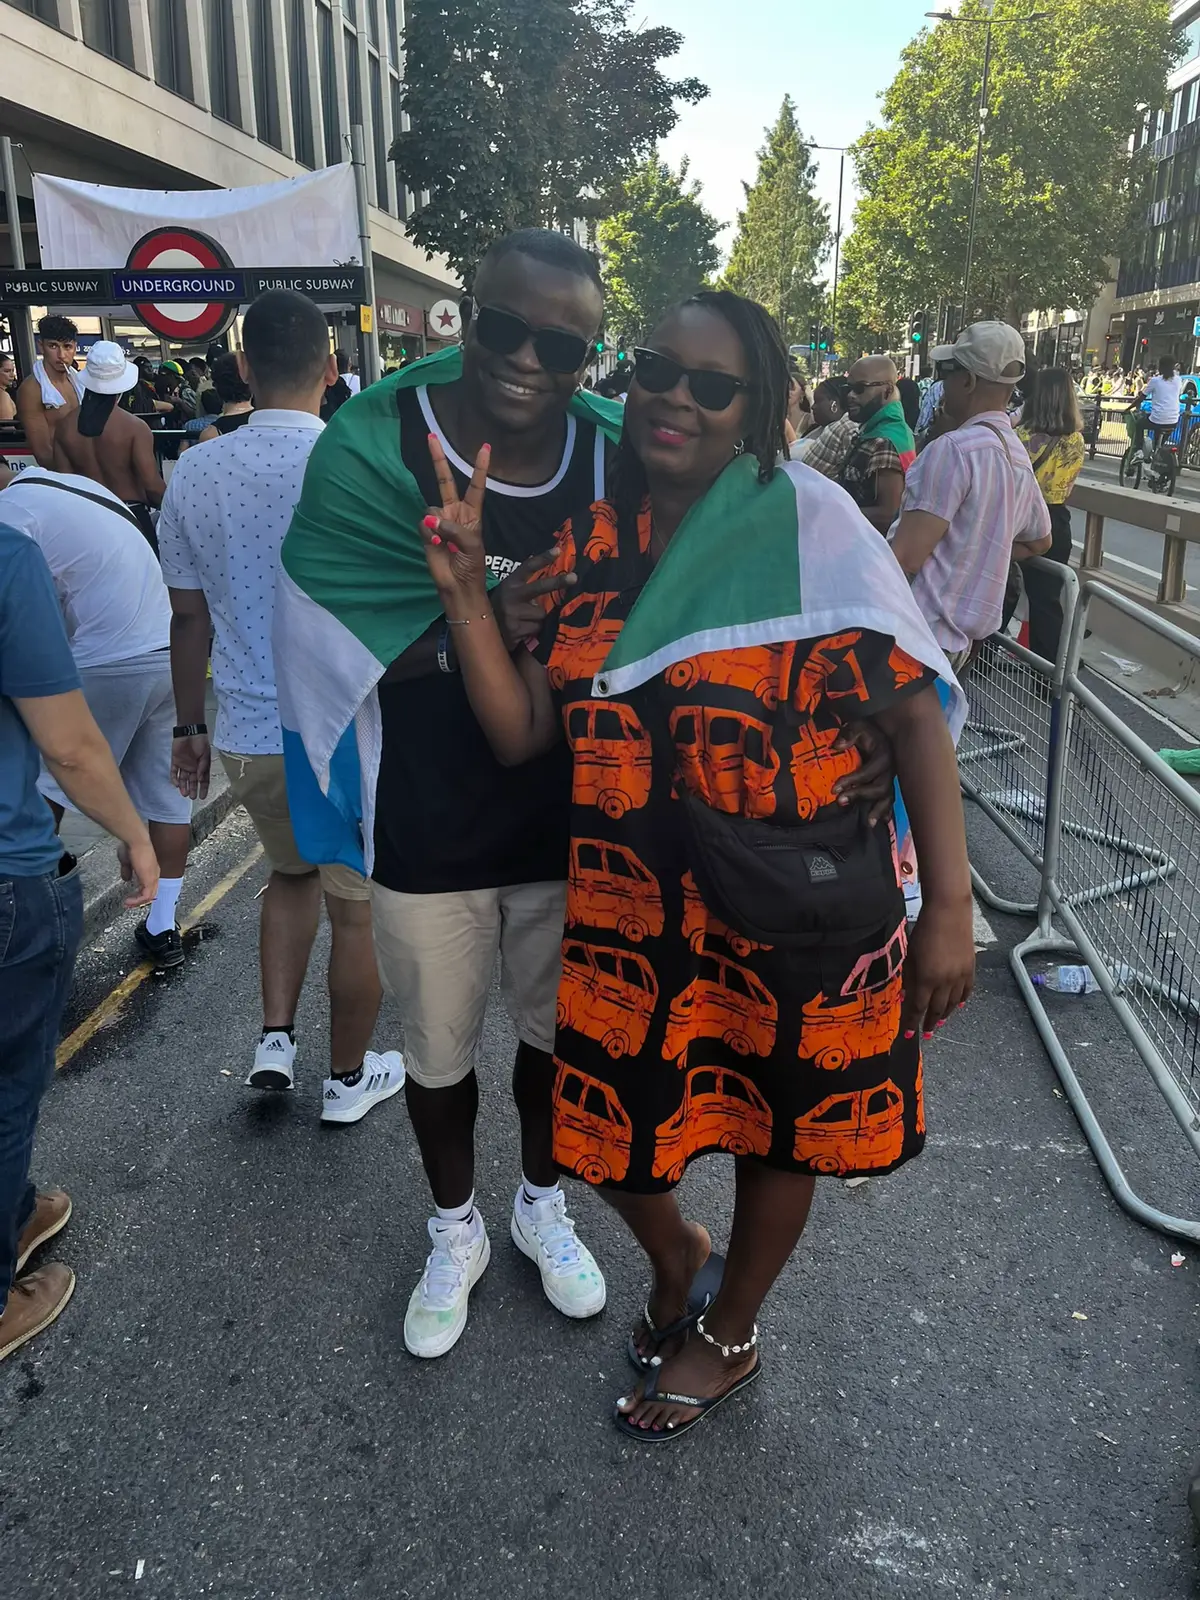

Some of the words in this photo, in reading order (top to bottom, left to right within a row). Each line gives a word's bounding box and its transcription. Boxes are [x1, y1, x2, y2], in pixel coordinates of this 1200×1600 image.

[5, 281, 48, 293] PUBLIC
[51, 281, 99, 292] SUBWAY
[121, 279, 236, 292] UNDERGROUND
[258, 279, 302, 290] PUBLIC
[305, 278, 355, 290] SUBWAY
